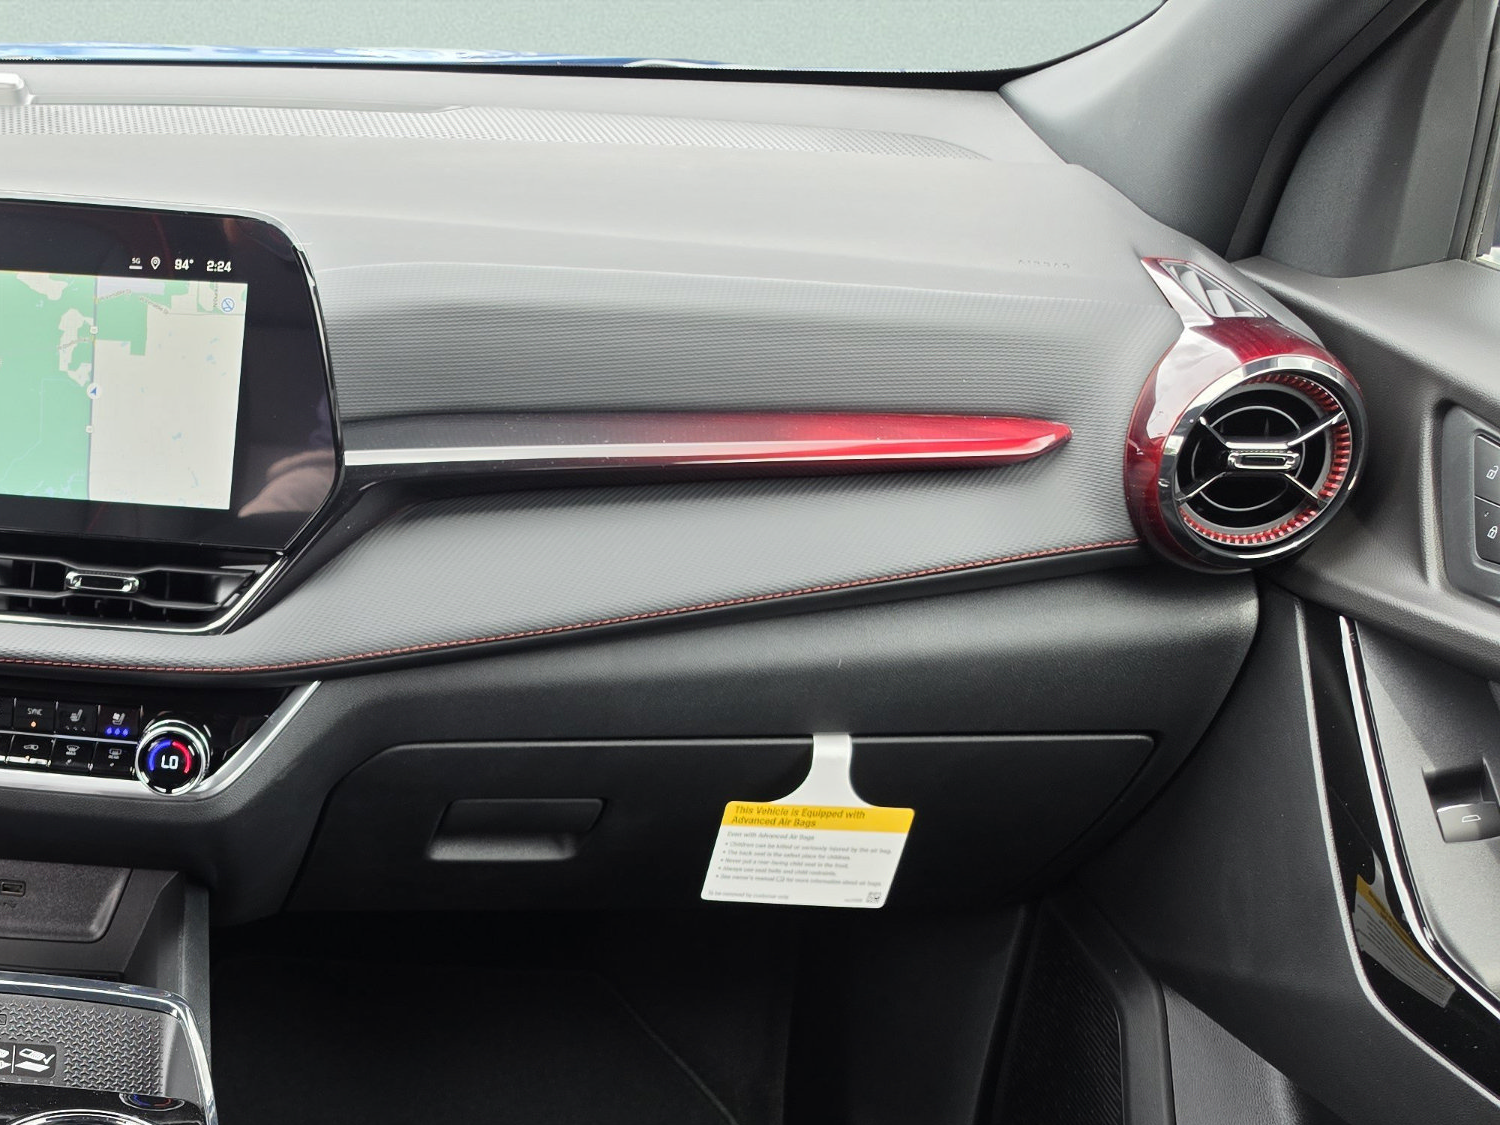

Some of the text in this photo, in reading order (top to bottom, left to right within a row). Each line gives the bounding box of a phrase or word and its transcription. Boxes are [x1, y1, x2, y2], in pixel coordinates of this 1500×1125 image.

[131, 257, 141, 265] 5G
[174, 259, 194, 270] 94°
[206, 260, 232, 273] 2:24
[27, 707, 43, 716] SYNC
[160, 755, 179, 770] LO
[736, 805, 865, 819] This Vehicle is Equipped with
[731, 815, 816, 828] Advanced Air Bags
